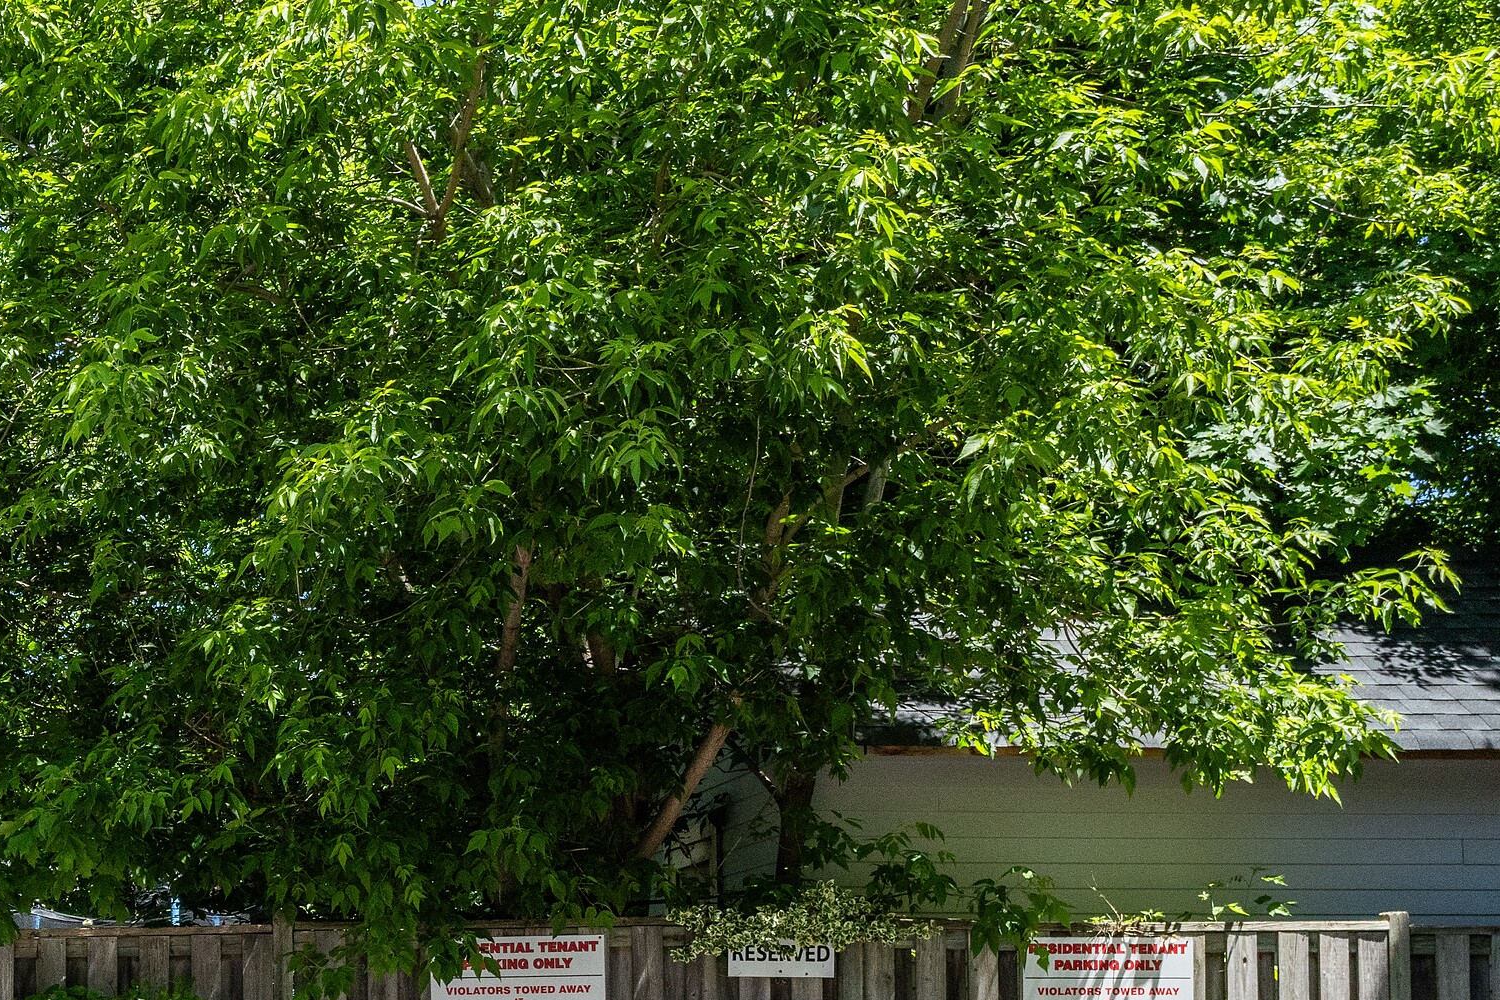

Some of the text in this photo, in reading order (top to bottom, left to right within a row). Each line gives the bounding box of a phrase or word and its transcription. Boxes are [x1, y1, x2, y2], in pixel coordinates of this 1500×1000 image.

[538, 941, 599, 953] TENANT
[1131, 943, 1188, 955] TENANT
[533, 957, 573, 969] ONLY
[1054, 959, 1163, 971] PARKING ONLY
[446, 984, 591, 996] VIOLATORS TOWED AWAY
[1037, 987, 1180, 996] VIOLATORS TOWED AWAY
